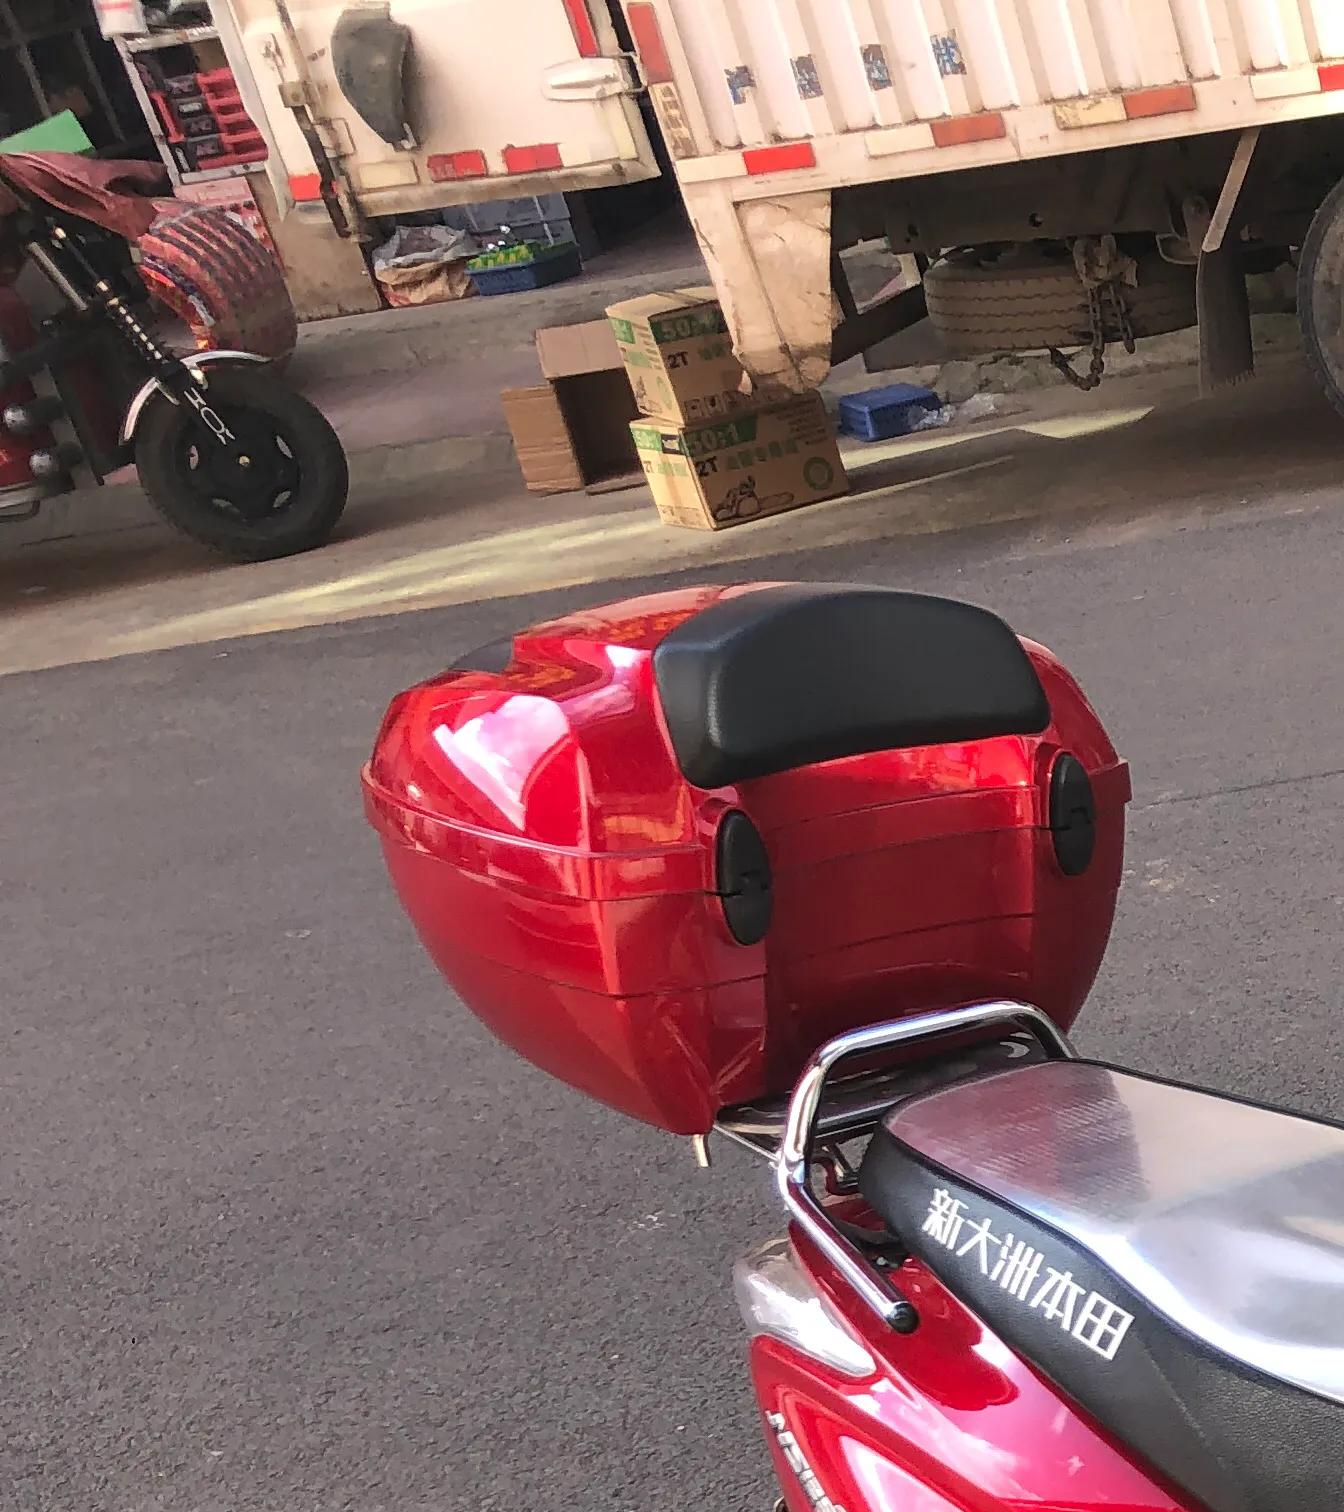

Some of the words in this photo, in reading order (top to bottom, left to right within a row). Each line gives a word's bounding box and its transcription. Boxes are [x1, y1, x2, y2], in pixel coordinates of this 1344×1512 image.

[921, 1188, 1136, 1361] 新大洲本田
